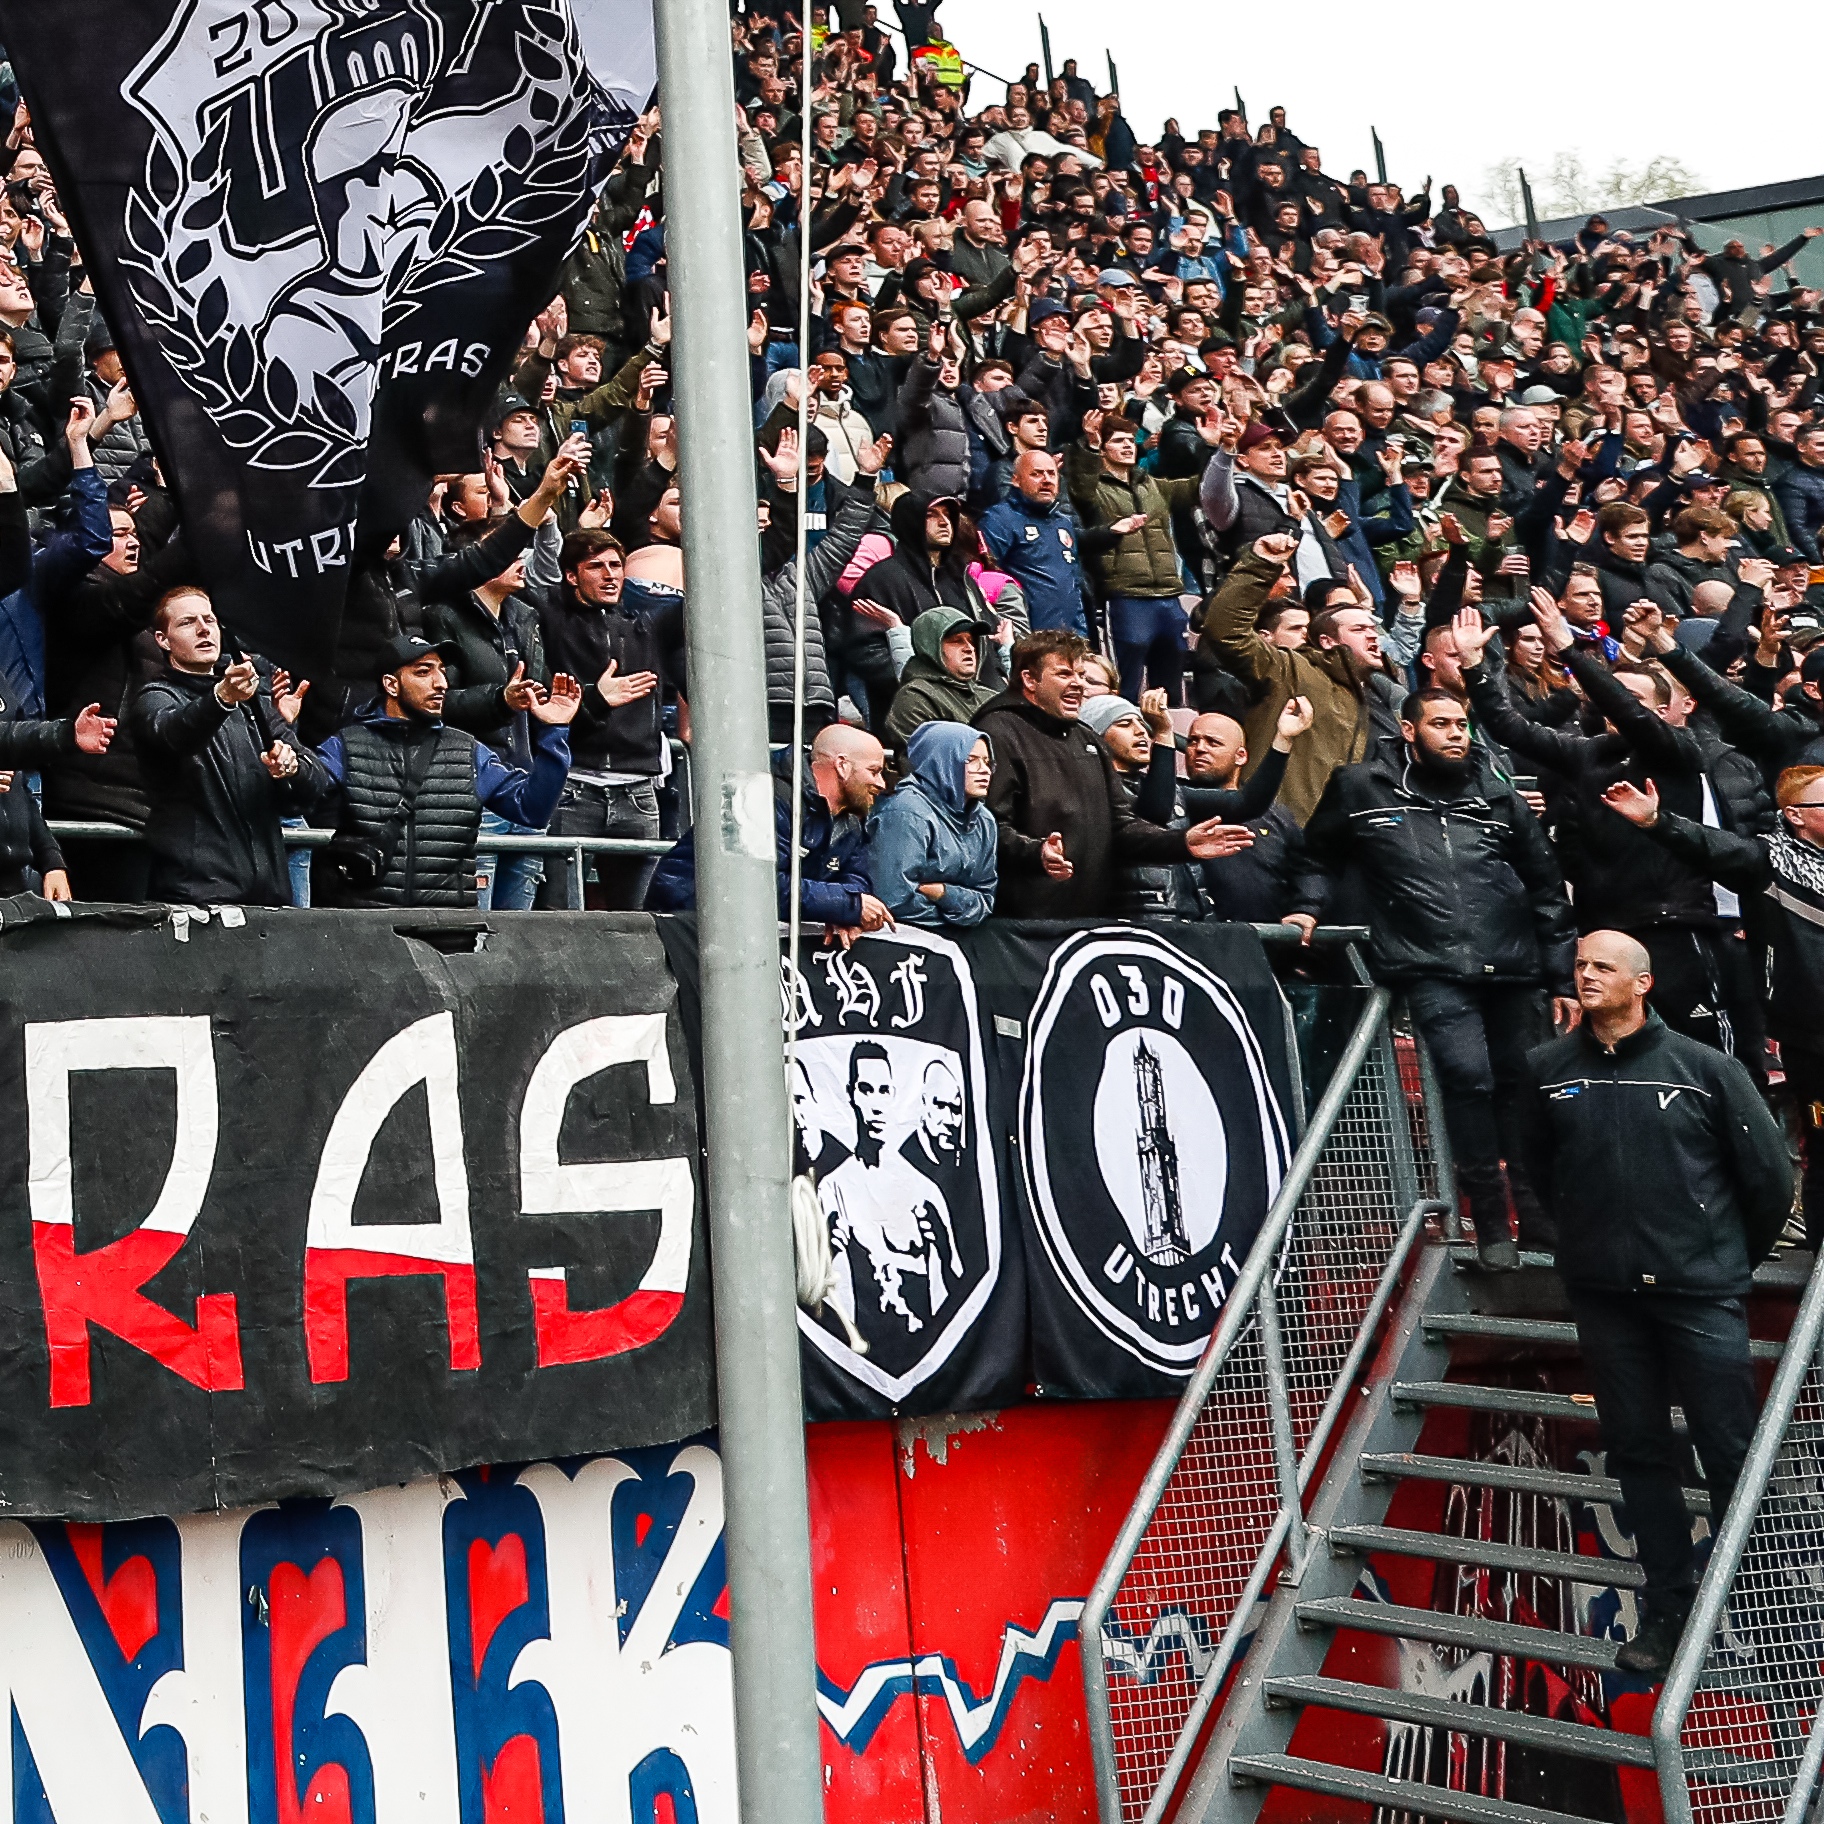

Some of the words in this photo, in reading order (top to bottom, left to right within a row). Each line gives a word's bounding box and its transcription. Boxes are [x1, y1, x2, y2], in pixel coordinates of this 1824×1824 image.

[376, 339, 491, 389] TRAS
[1090, 964, 1185, 1029] 030
[1103, 1242, 1242, 1326] UTRECHT
